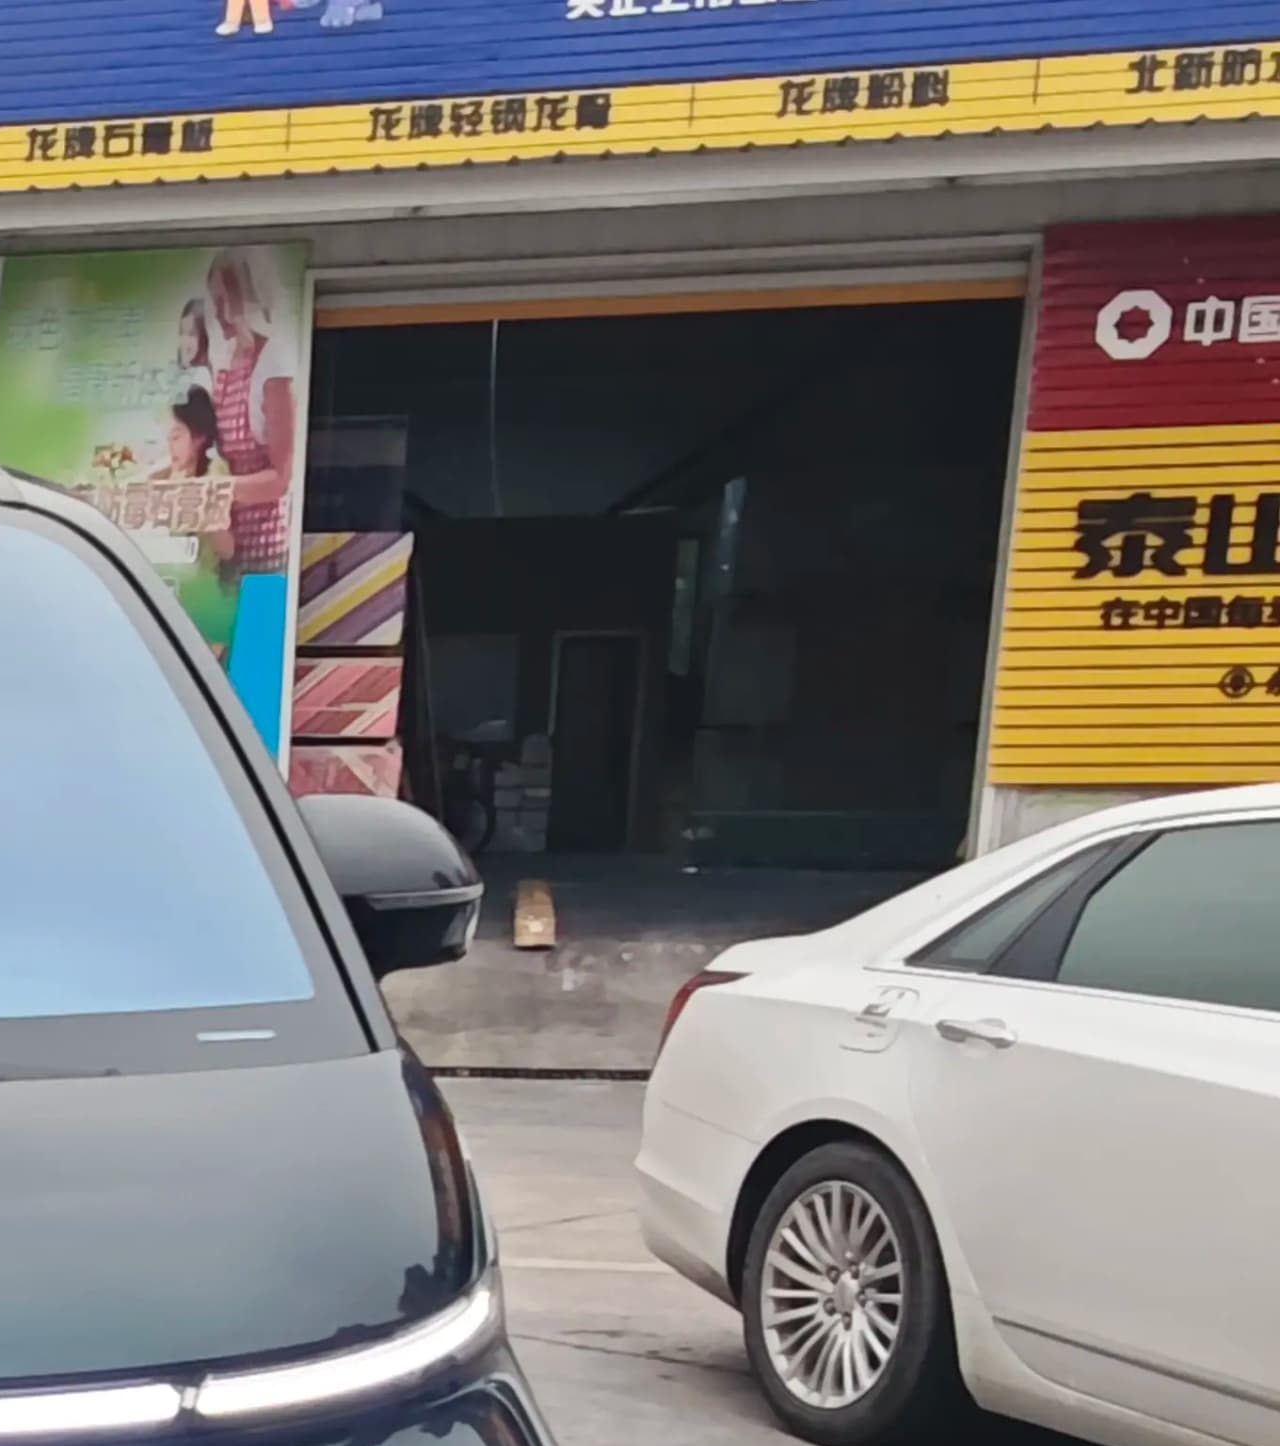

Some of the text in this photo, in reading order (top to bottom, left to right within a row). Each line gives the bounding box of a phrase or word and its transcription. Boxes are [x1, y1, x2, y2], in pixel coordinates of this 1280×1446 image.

[1124, 49, 1280, 95] 北新防
[367, 93, 612, 142] 龙牌轻钢龙骨
